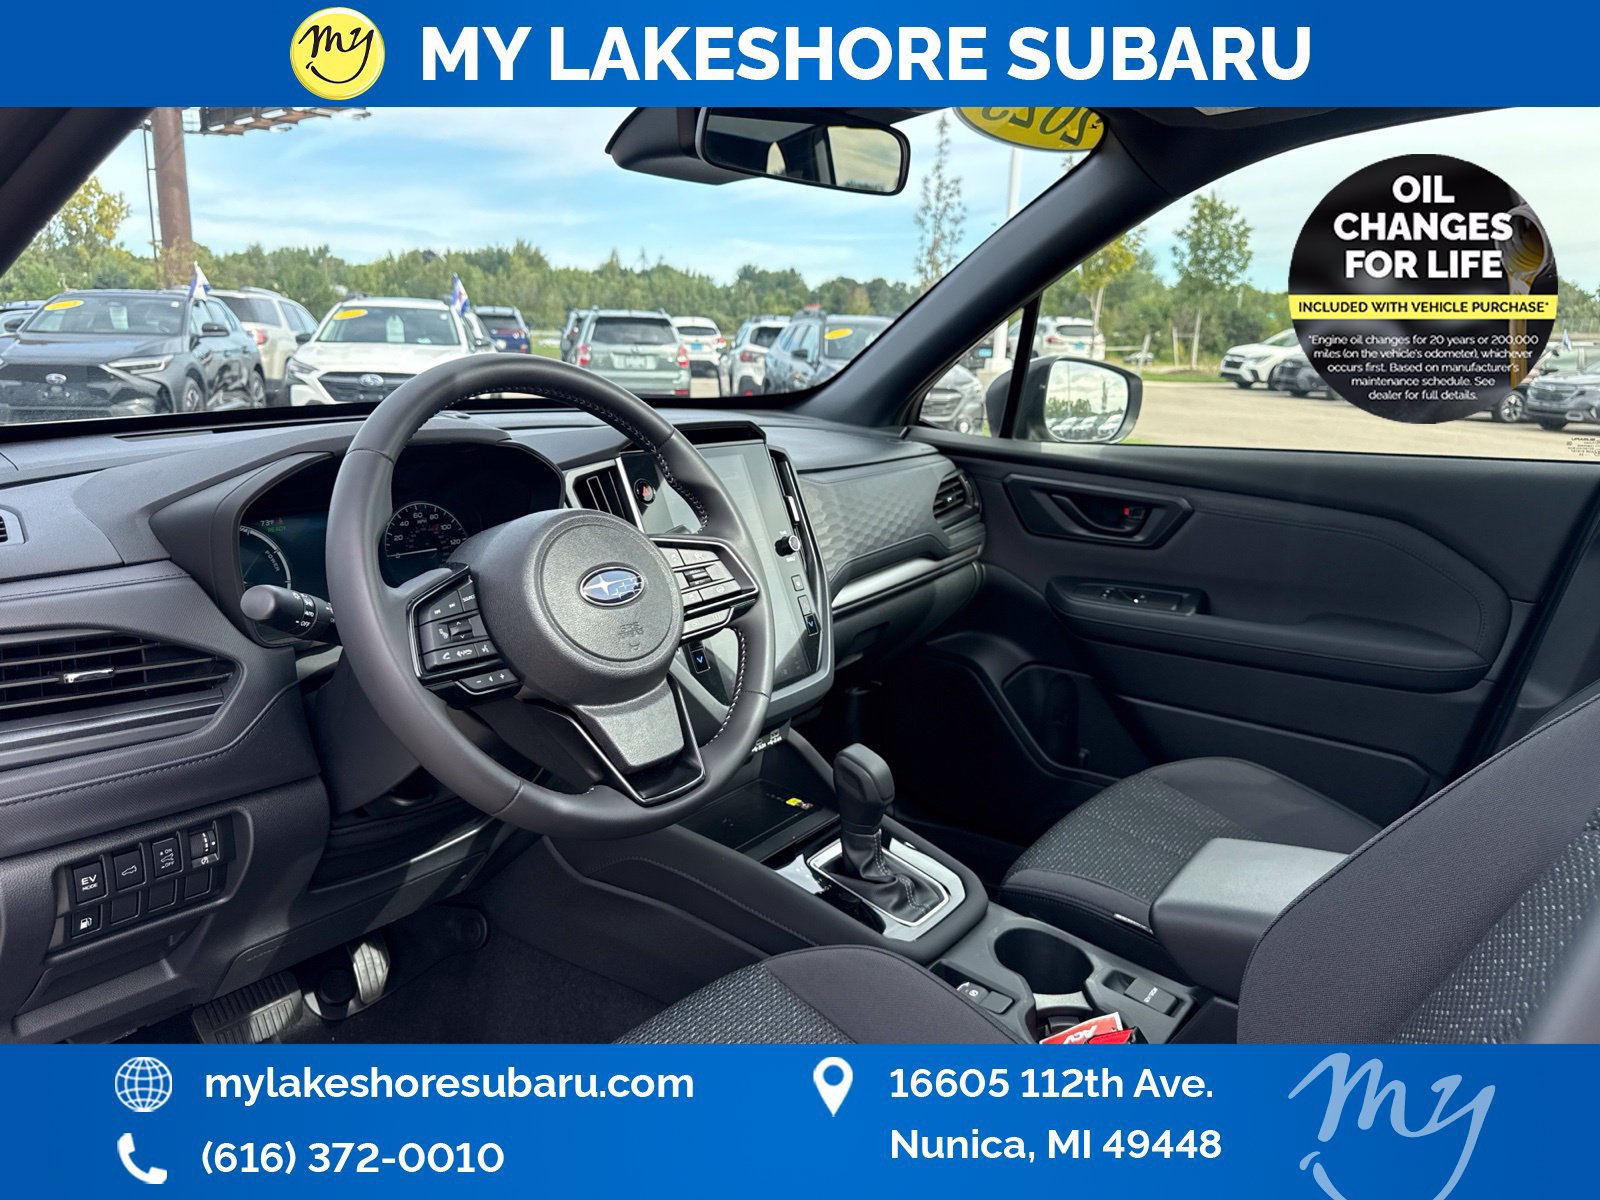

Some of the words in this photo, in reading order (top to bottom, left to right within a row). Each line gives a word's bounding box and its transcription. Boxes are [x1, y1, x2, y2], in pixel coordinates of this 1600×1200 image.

[440, 523, 452, 531] 100
[393, 534, 404, 542] 20
[450, 538, 461, 546] 120
[264, 550, 281, 572] POWER
[300, 620, 311, 628] OFF
[81, 873, 97, 886] EV
[81, 881, 98, 892] MODE
